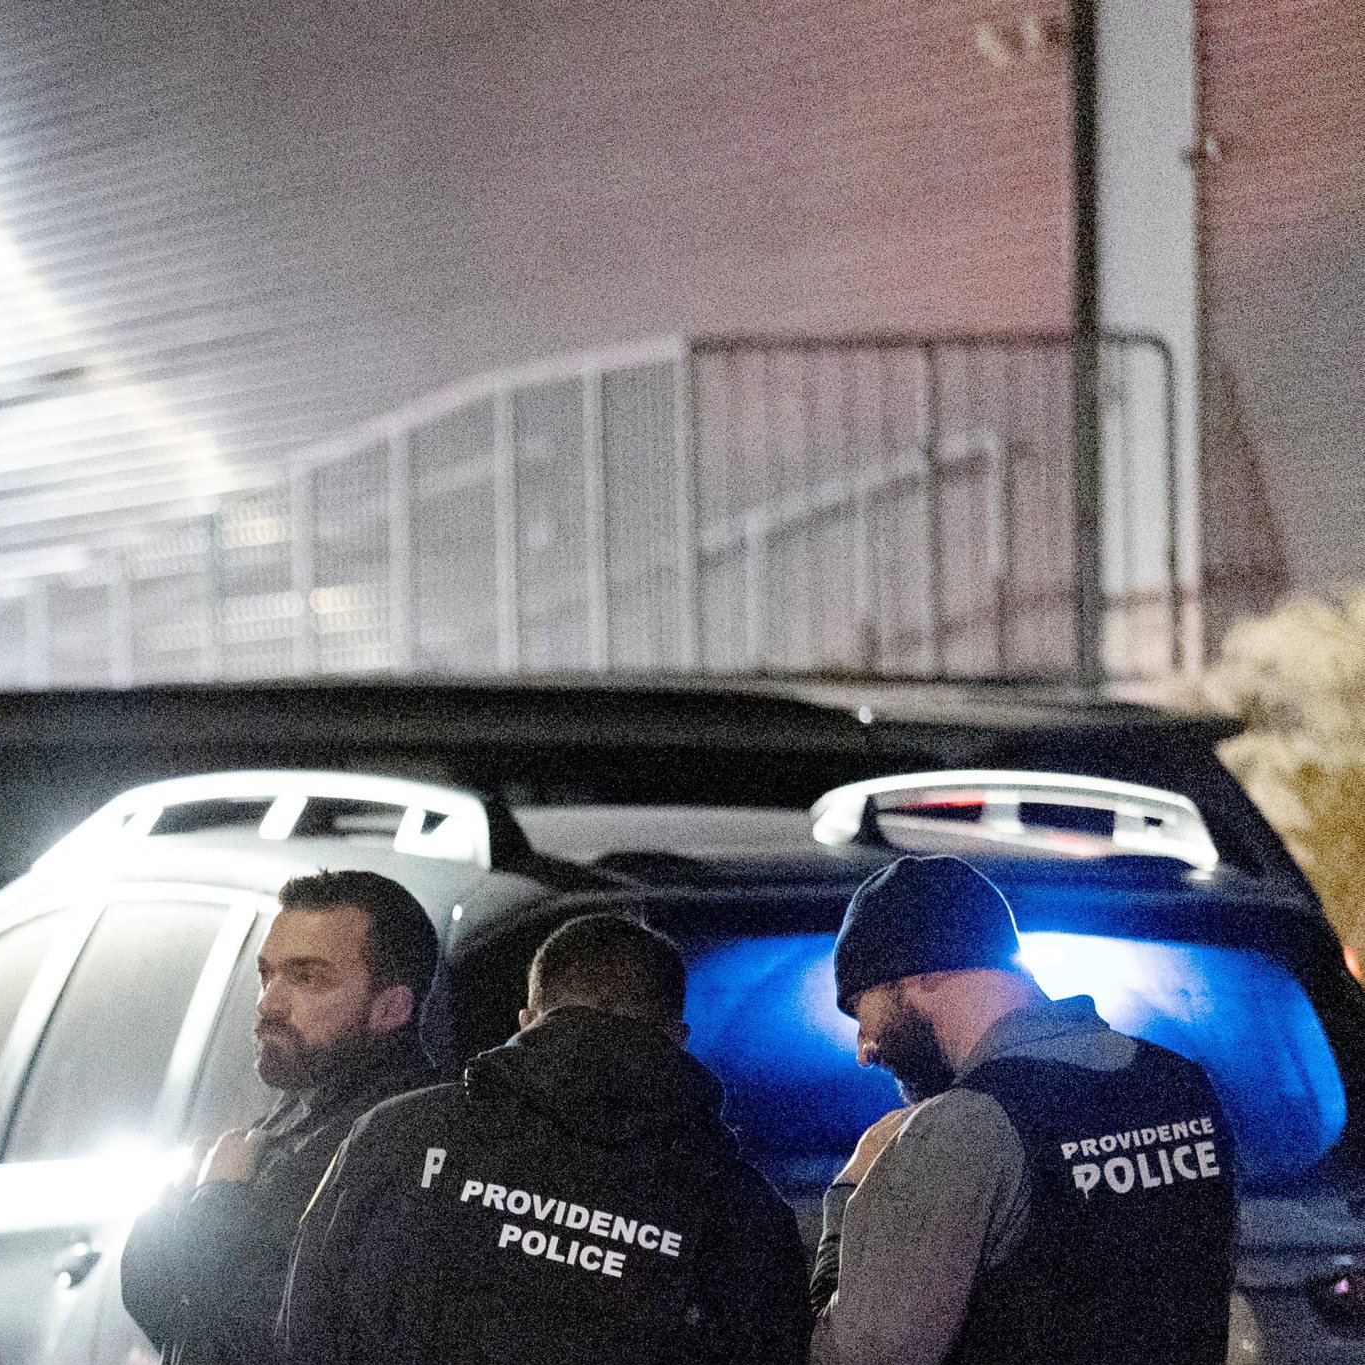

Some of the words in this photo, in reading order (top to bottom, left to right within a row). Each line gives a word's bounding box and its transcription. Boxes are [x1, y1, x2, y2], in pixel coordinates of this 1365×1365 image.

[1060, 1117, 1215, 1160] PROVIDENCE
[1072, 1141, 1221, 1199] POLICE
[460, 1180, 682, 1257] PROVIDENCE
[498, 1224, 627, 1278] POLICE
